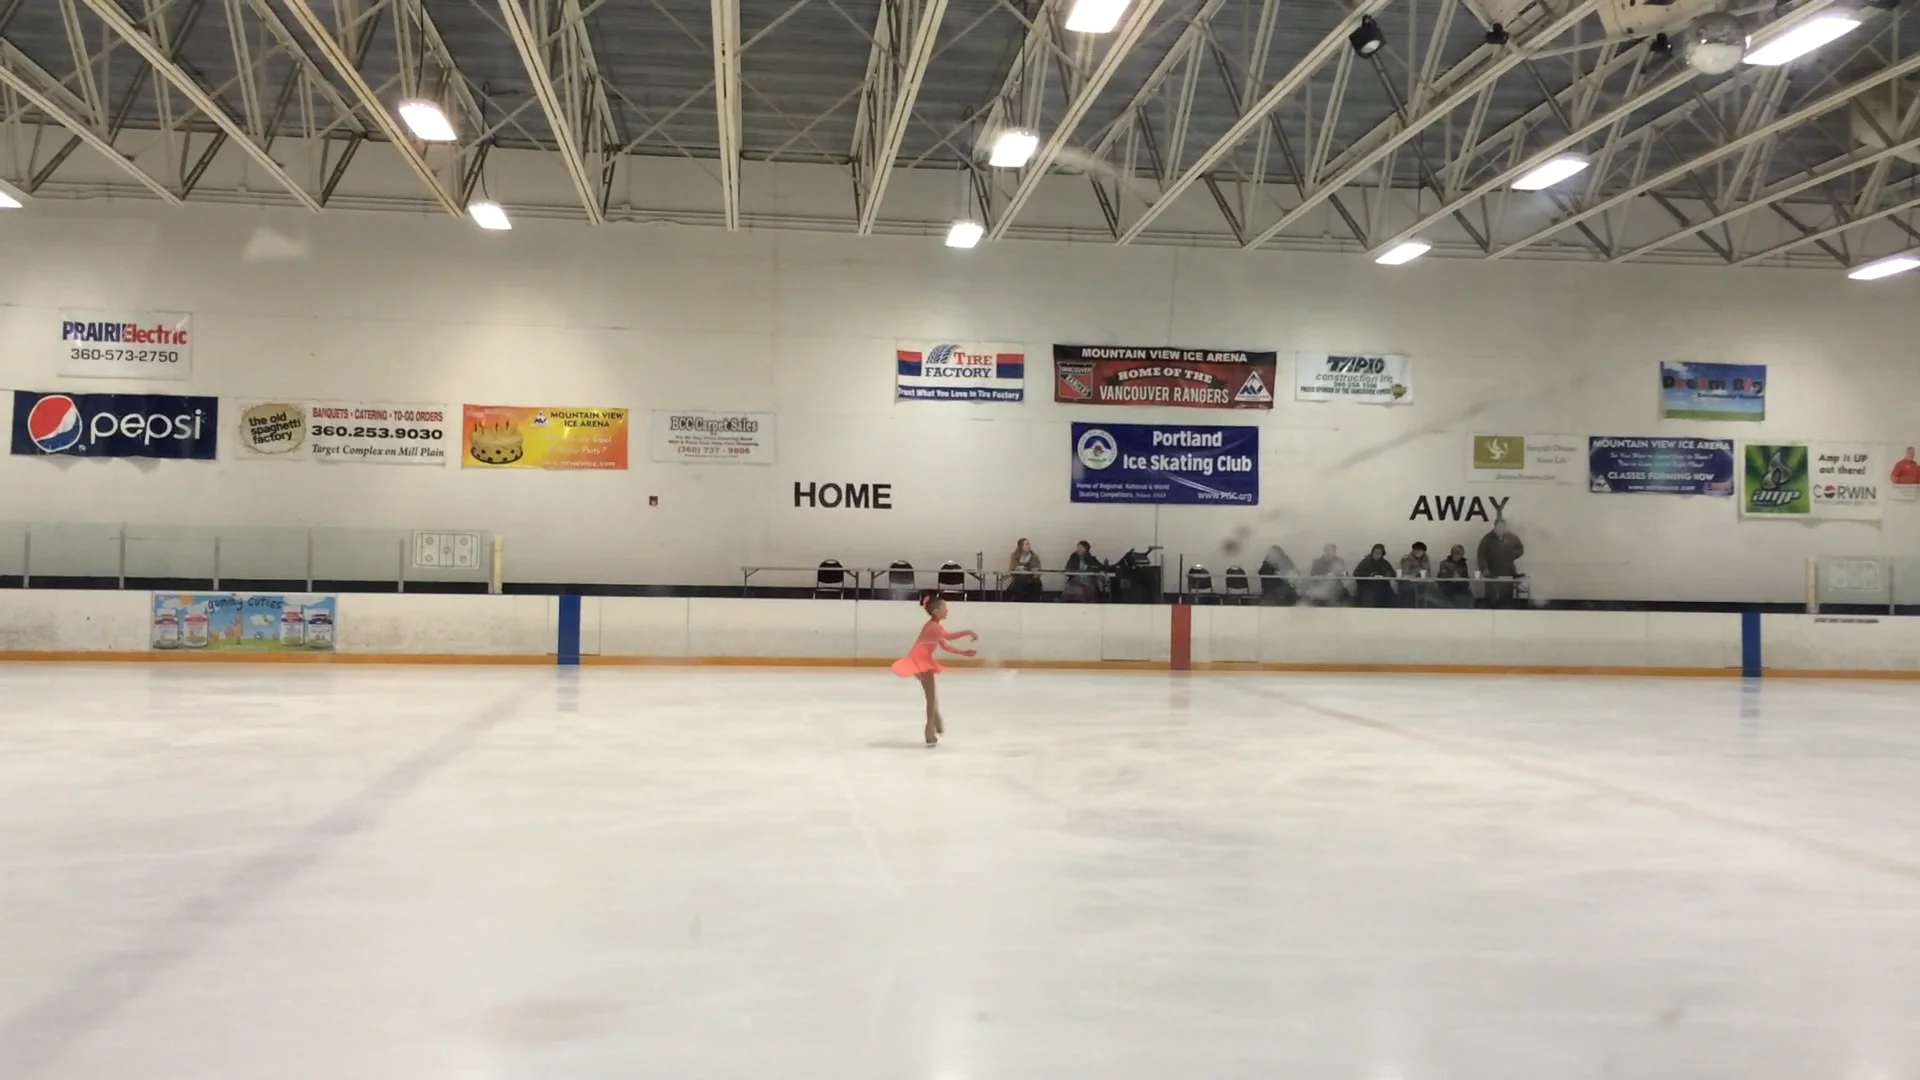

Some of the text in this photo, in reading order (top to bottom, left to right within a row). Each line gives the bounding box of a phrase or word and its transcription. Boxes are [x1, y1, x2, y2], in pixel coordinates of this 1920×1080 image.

[71, 348, 179, 362] 360-573-2750
[953, 352, 993, 365] TIRE
[1081, 348, 1247, 362] MOUNTAIN VIEW ICE ARENA
[1326, 355, 1386, 374] TAPIO
[924, 367, 992, 378] FACTORY
[1117, 367, 1213, 383] HOME OF THE
[1315, 373, 1379, 384] construction
[917, 388, 935, 397] What
[937, 389, 949, 398] You
[951, 390, 968, 398] Love
[978, 390, 990, 398] Tire
[992, 391, 1020, 400] Factory
[1099, 385, 1229, 403] VANCOUVER RANGERS
[248, 411, 287, 427] the old
[312, 407, 443, 422] BANQUETS CATERING TO-GO ORDERS
[550, 411, 624, 420] MOUNTAIN VIEW
[90, 409, 202, 446] pepsi
[250, 418, 302, 436] spaghetti
[311, 425, 443, 440] 360.253.9030
[670, 416, 759, 435] BCC Carpet Sales
[252, 431, 293, 445] factory
[1152, 431, 1223, 447] Portland
[1592, 440, 1731, 450] MOUNTAIN VIEW ICE ARENA
[311, 444, 445, 457] Target Complex on Mill Plain
[1123, 454, 1253, 475] Ice Skating Club
[1818, 454, 1840, 463] Amp
[1854, 454, 1869, 463] UP
[1607, 471, 1715, 481] CLASSES FORMING NOW
[1837, 466, 1866, 475] there!
[794, 481, 893, 509] HOME
[1408, 495, 1510, 522] AWAY
[207, 597, 243, 613] gummy
